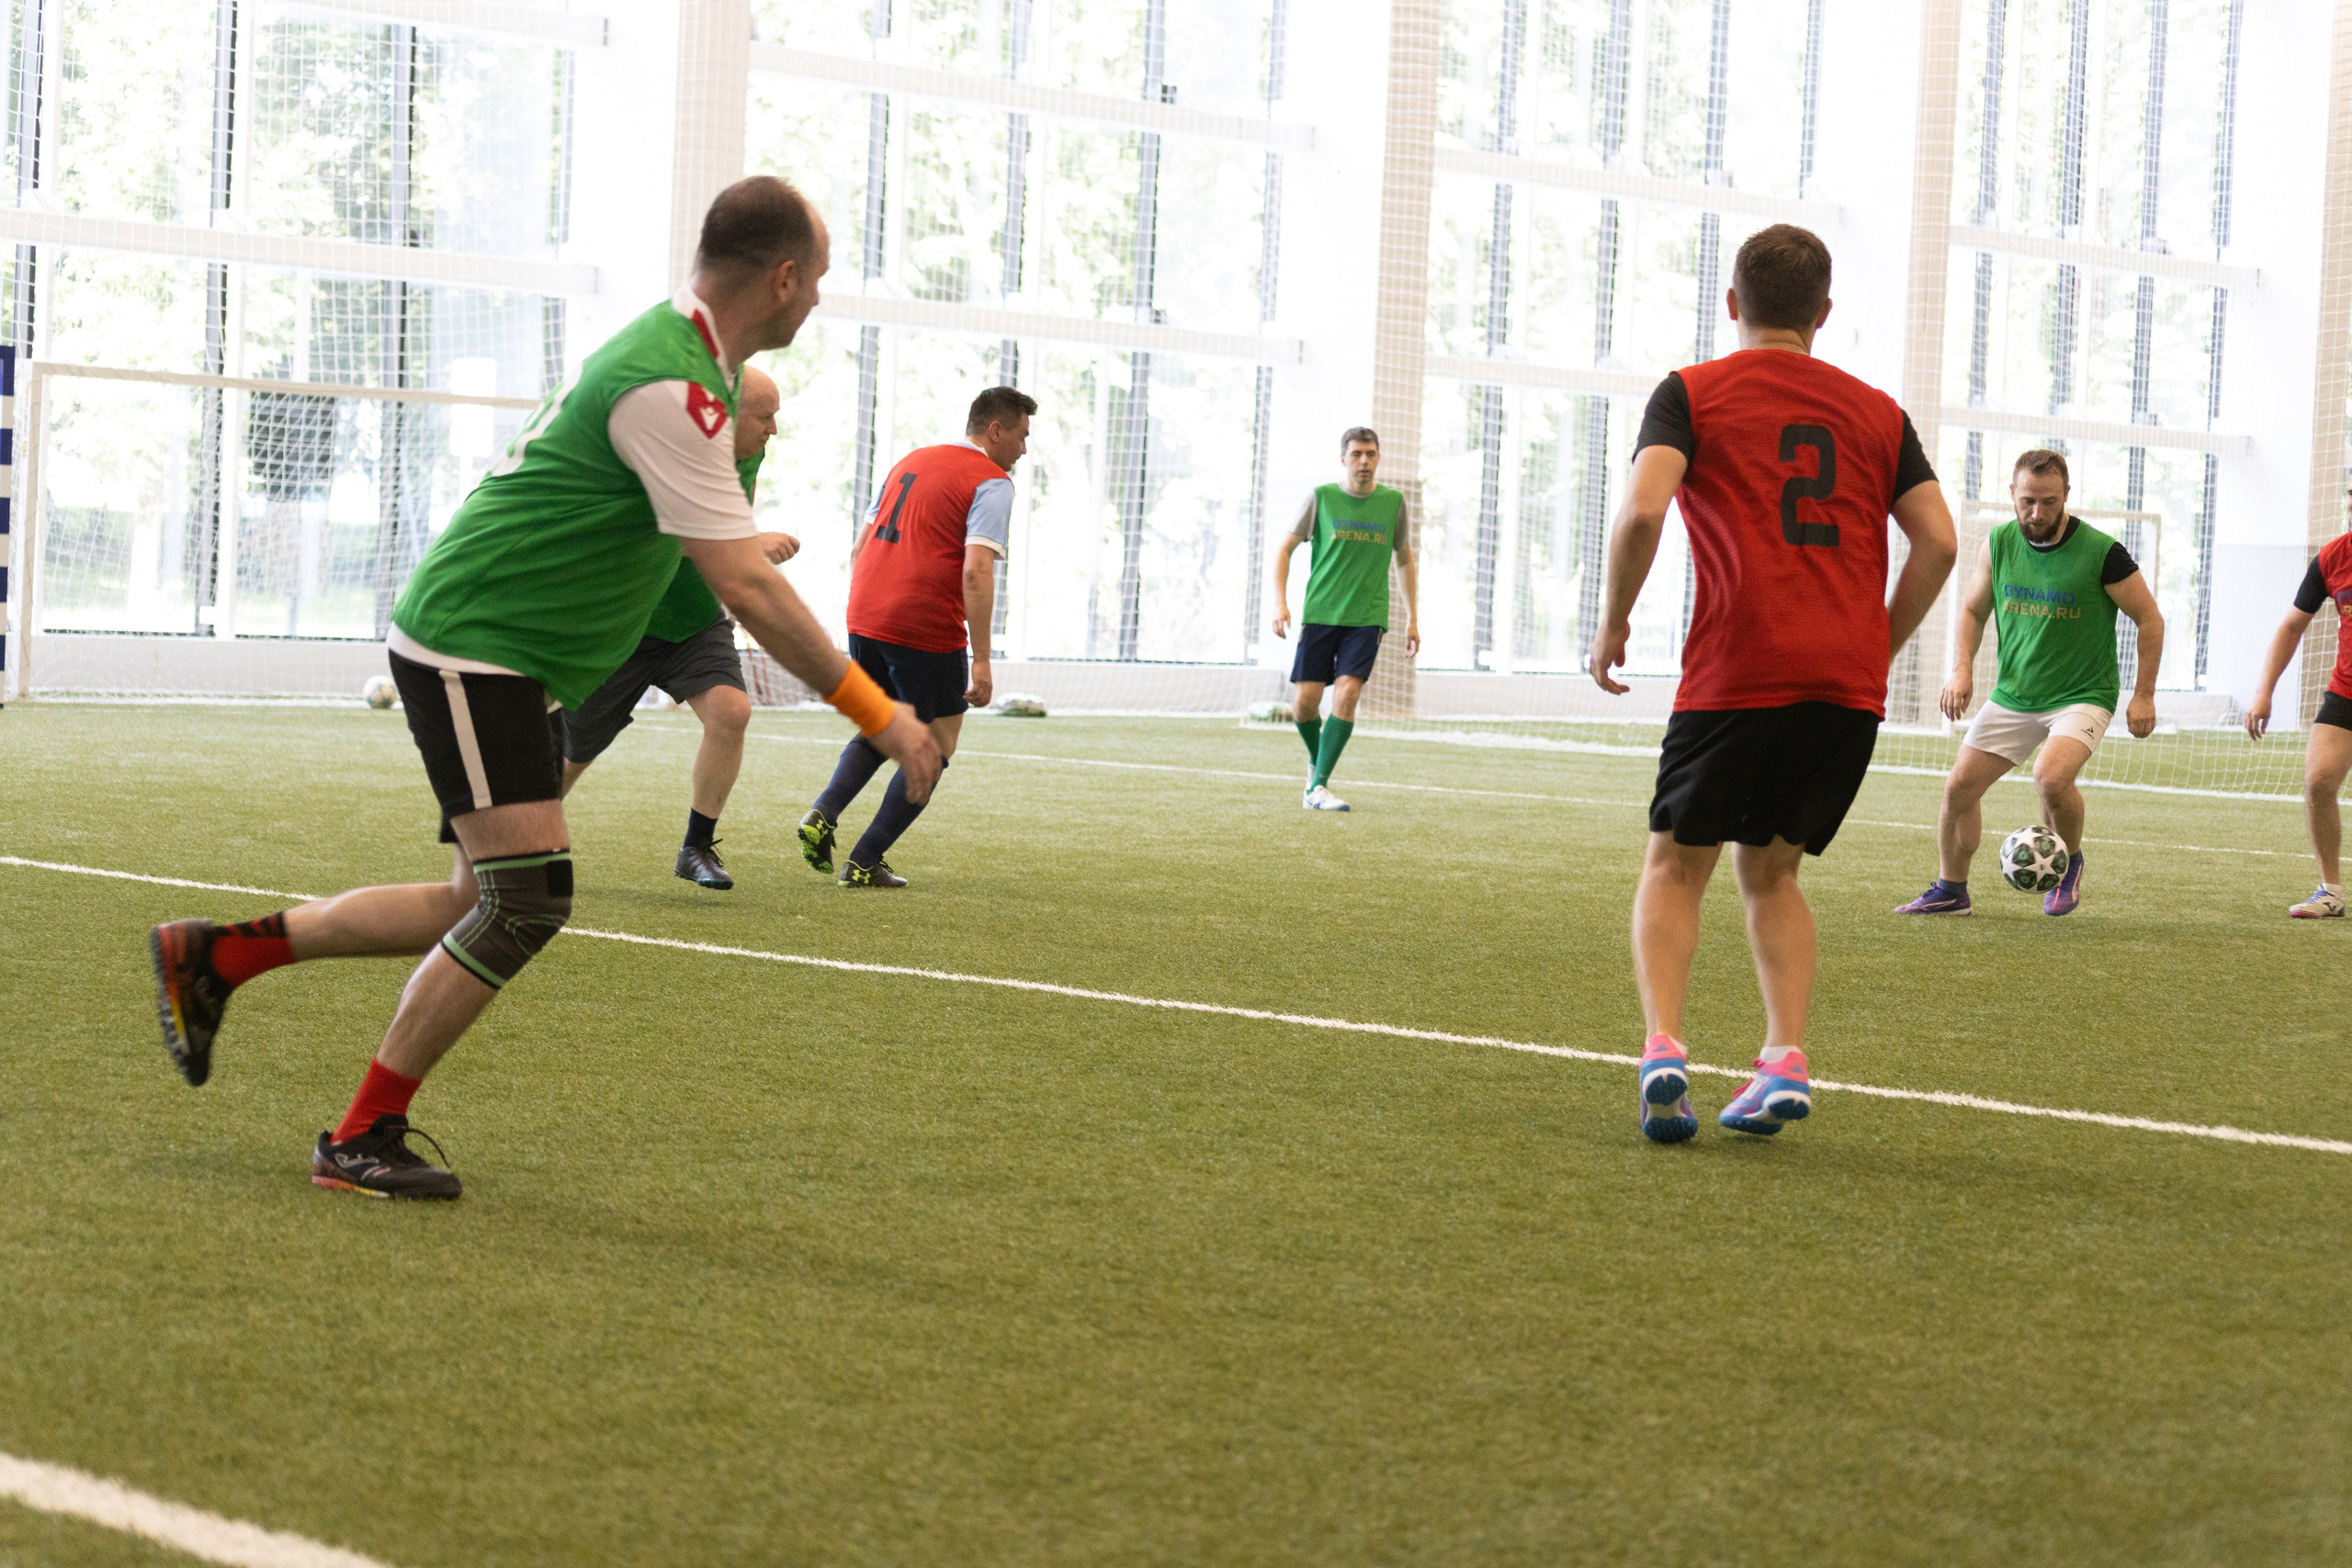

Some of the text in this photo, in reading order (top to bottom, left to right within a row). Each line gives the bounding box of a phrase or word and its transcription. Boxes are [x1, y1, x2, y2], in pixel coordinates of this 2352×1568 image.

[1779, 423, 1840, 547] 2
[876, 471, 918, 545] 1
[1333, 519, 1386, 534] DYNAMO
[2004, 584, 2075, 605] DYNAMO
[2003, 600, 2081, 619] ARENA.RU
